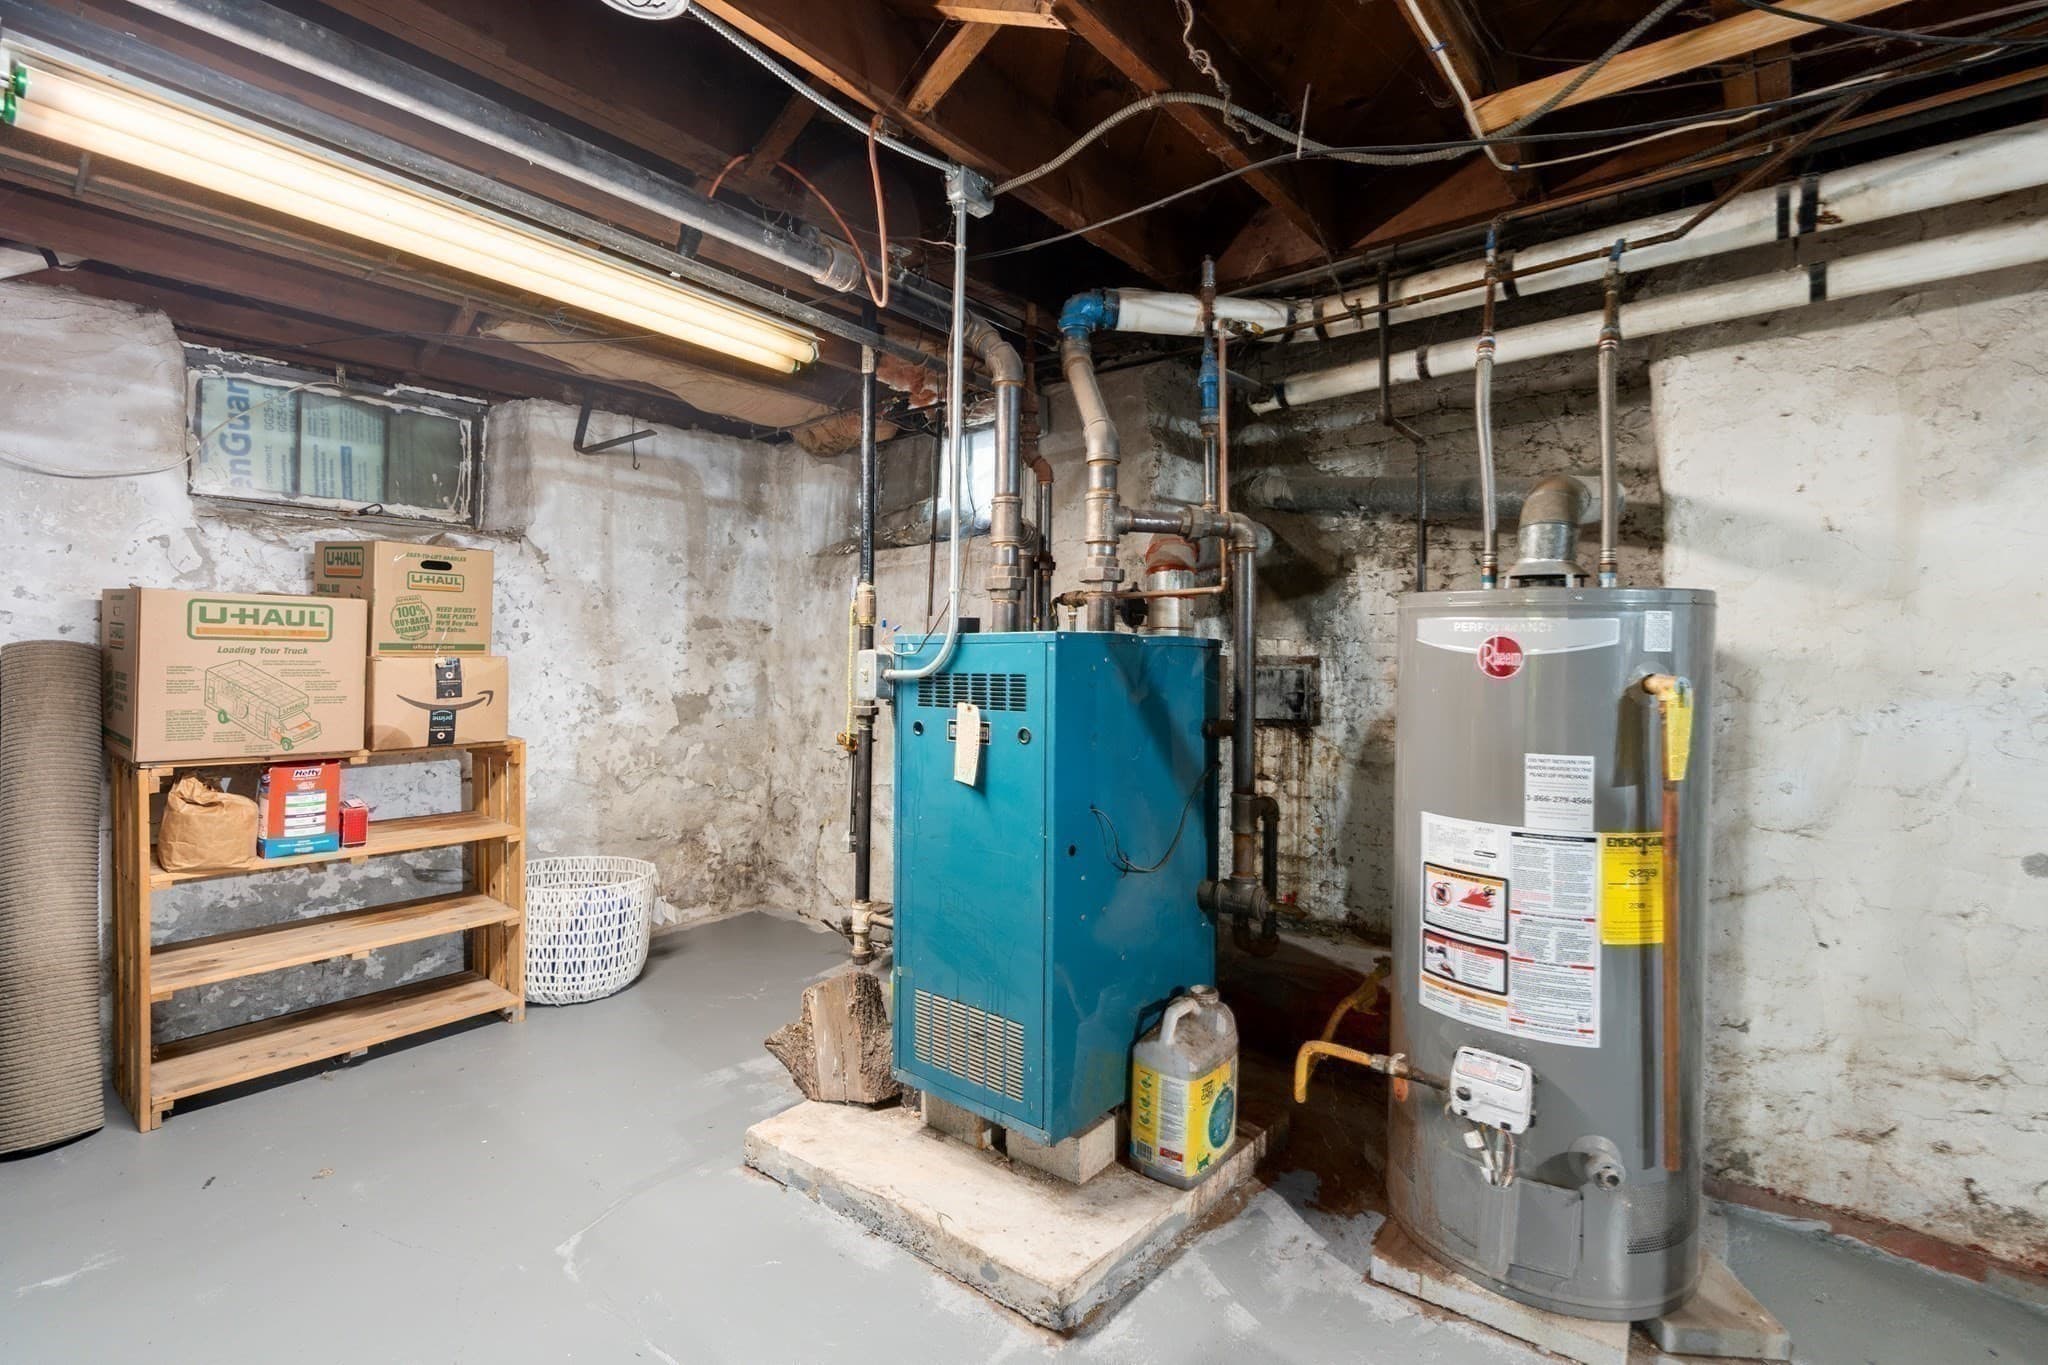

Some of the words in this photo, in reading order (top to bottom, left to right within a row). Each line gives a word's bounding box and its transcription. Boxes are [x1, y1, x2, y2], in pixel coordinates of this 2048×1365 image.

[326, 552, 361, 566] U-HAUL
[411, 574, 461, 586] U-HAUL
[198, 606, 325, 627] U-HAUL
[397, 605, 426, 618] 100%
[394, 616, 430, 627] BUY-BACK
[217, 646, 256, 655] Loading
[259, 646, 280, 655] Your
[284, 647, 308, 655] Truck
[1479, 635, 1521, 672] Rheem
[295, 769, 321, 777] Hefty
